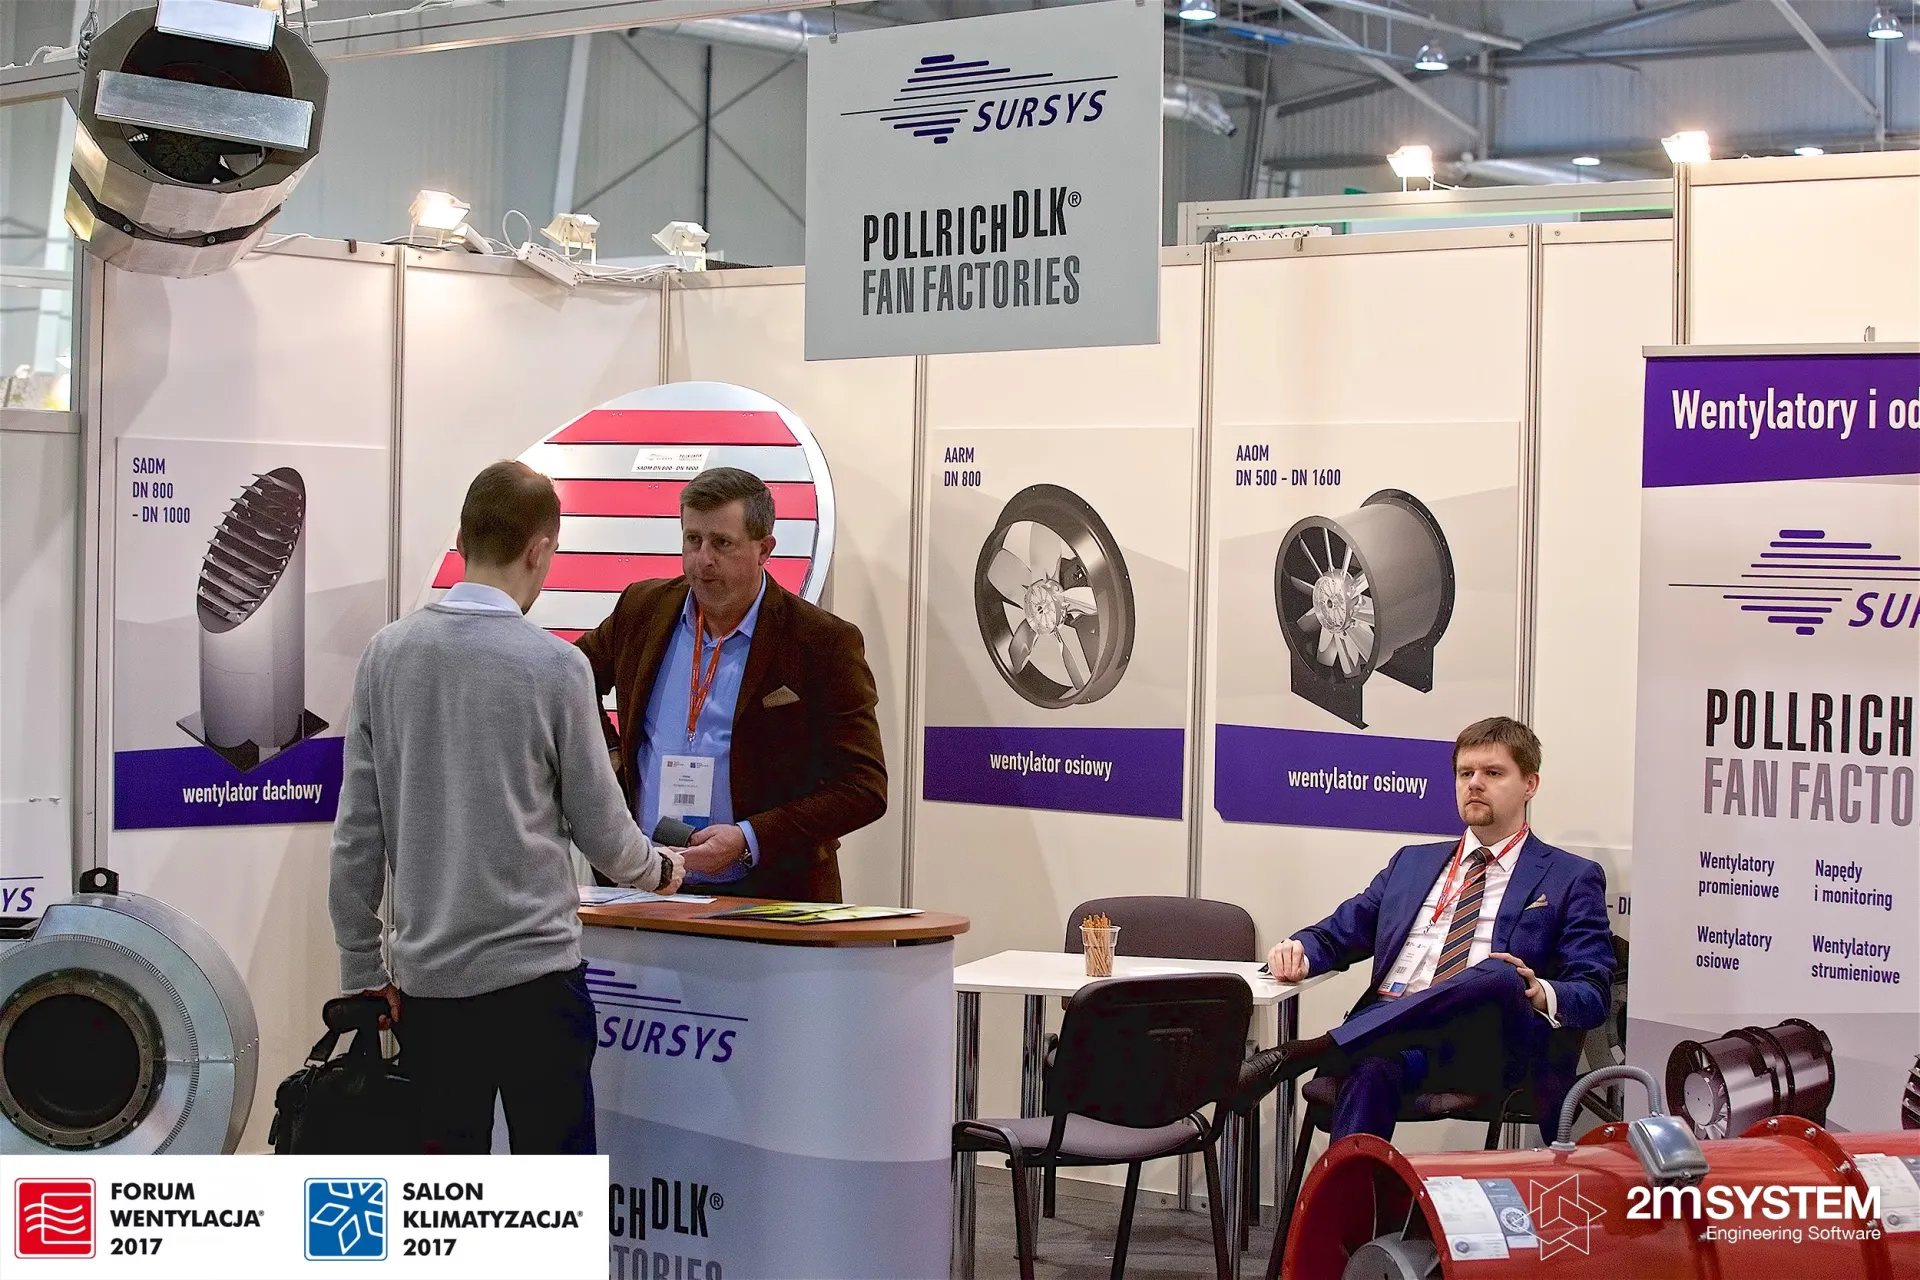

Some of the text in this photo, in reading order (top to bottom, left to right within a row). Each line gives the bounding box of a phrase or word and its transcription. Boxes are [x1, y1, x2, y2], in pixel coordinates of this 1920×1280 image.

[973, 90, 1107, 132] SURSYS
[862, 255, 1080, 315] FAN FACTORIES
[1672, 387, 1858, 440] Wentylatory
[1868, 388, 1877, 429] i
[132, 457, 166, 474] SADM
[944, 447, 975, 462] AARM
[1236, 444, 1269, 461] AAOM
[132, 481, 174, 499] DN 800
[944, 470, 981, 487] DN 800
[1236, 470, 1252, 486] DN
[1255, 470, 1277, 486] 500
[1291, 470, 1308, 486] DN
[1312, 470, 1341, 486] 1600
[142, 505, 158, 523] DN
[163, 506, 191, 524] 1000
[1705, 688, 1913, 757] POLLRICH
[989, 750, 1113, 782] wentylator osiowy
[182, 779, 323, 806] wentylator dachowy
[1287, 766, 1428, 799] wentylator osiowy
[1704, 757, 1914, 827] FAN FACTO
[1699, 851, 1775, 877] Wentylatory
[1815, 860, 1863, 883] Napędy
[1698, 879, 1780, 899] promieniowe
[1814, 885, 1893, 911] i monitoring
[1697, 925, 1773, 952] Wentylatory
[1812, 934, 1891, 962] Wentylatory
[1696, 953, 1740, 971] osiowe
[1811, 963, 1900, 985] strumieniowe
[598, 1016, 737, 1063] SURSYS
